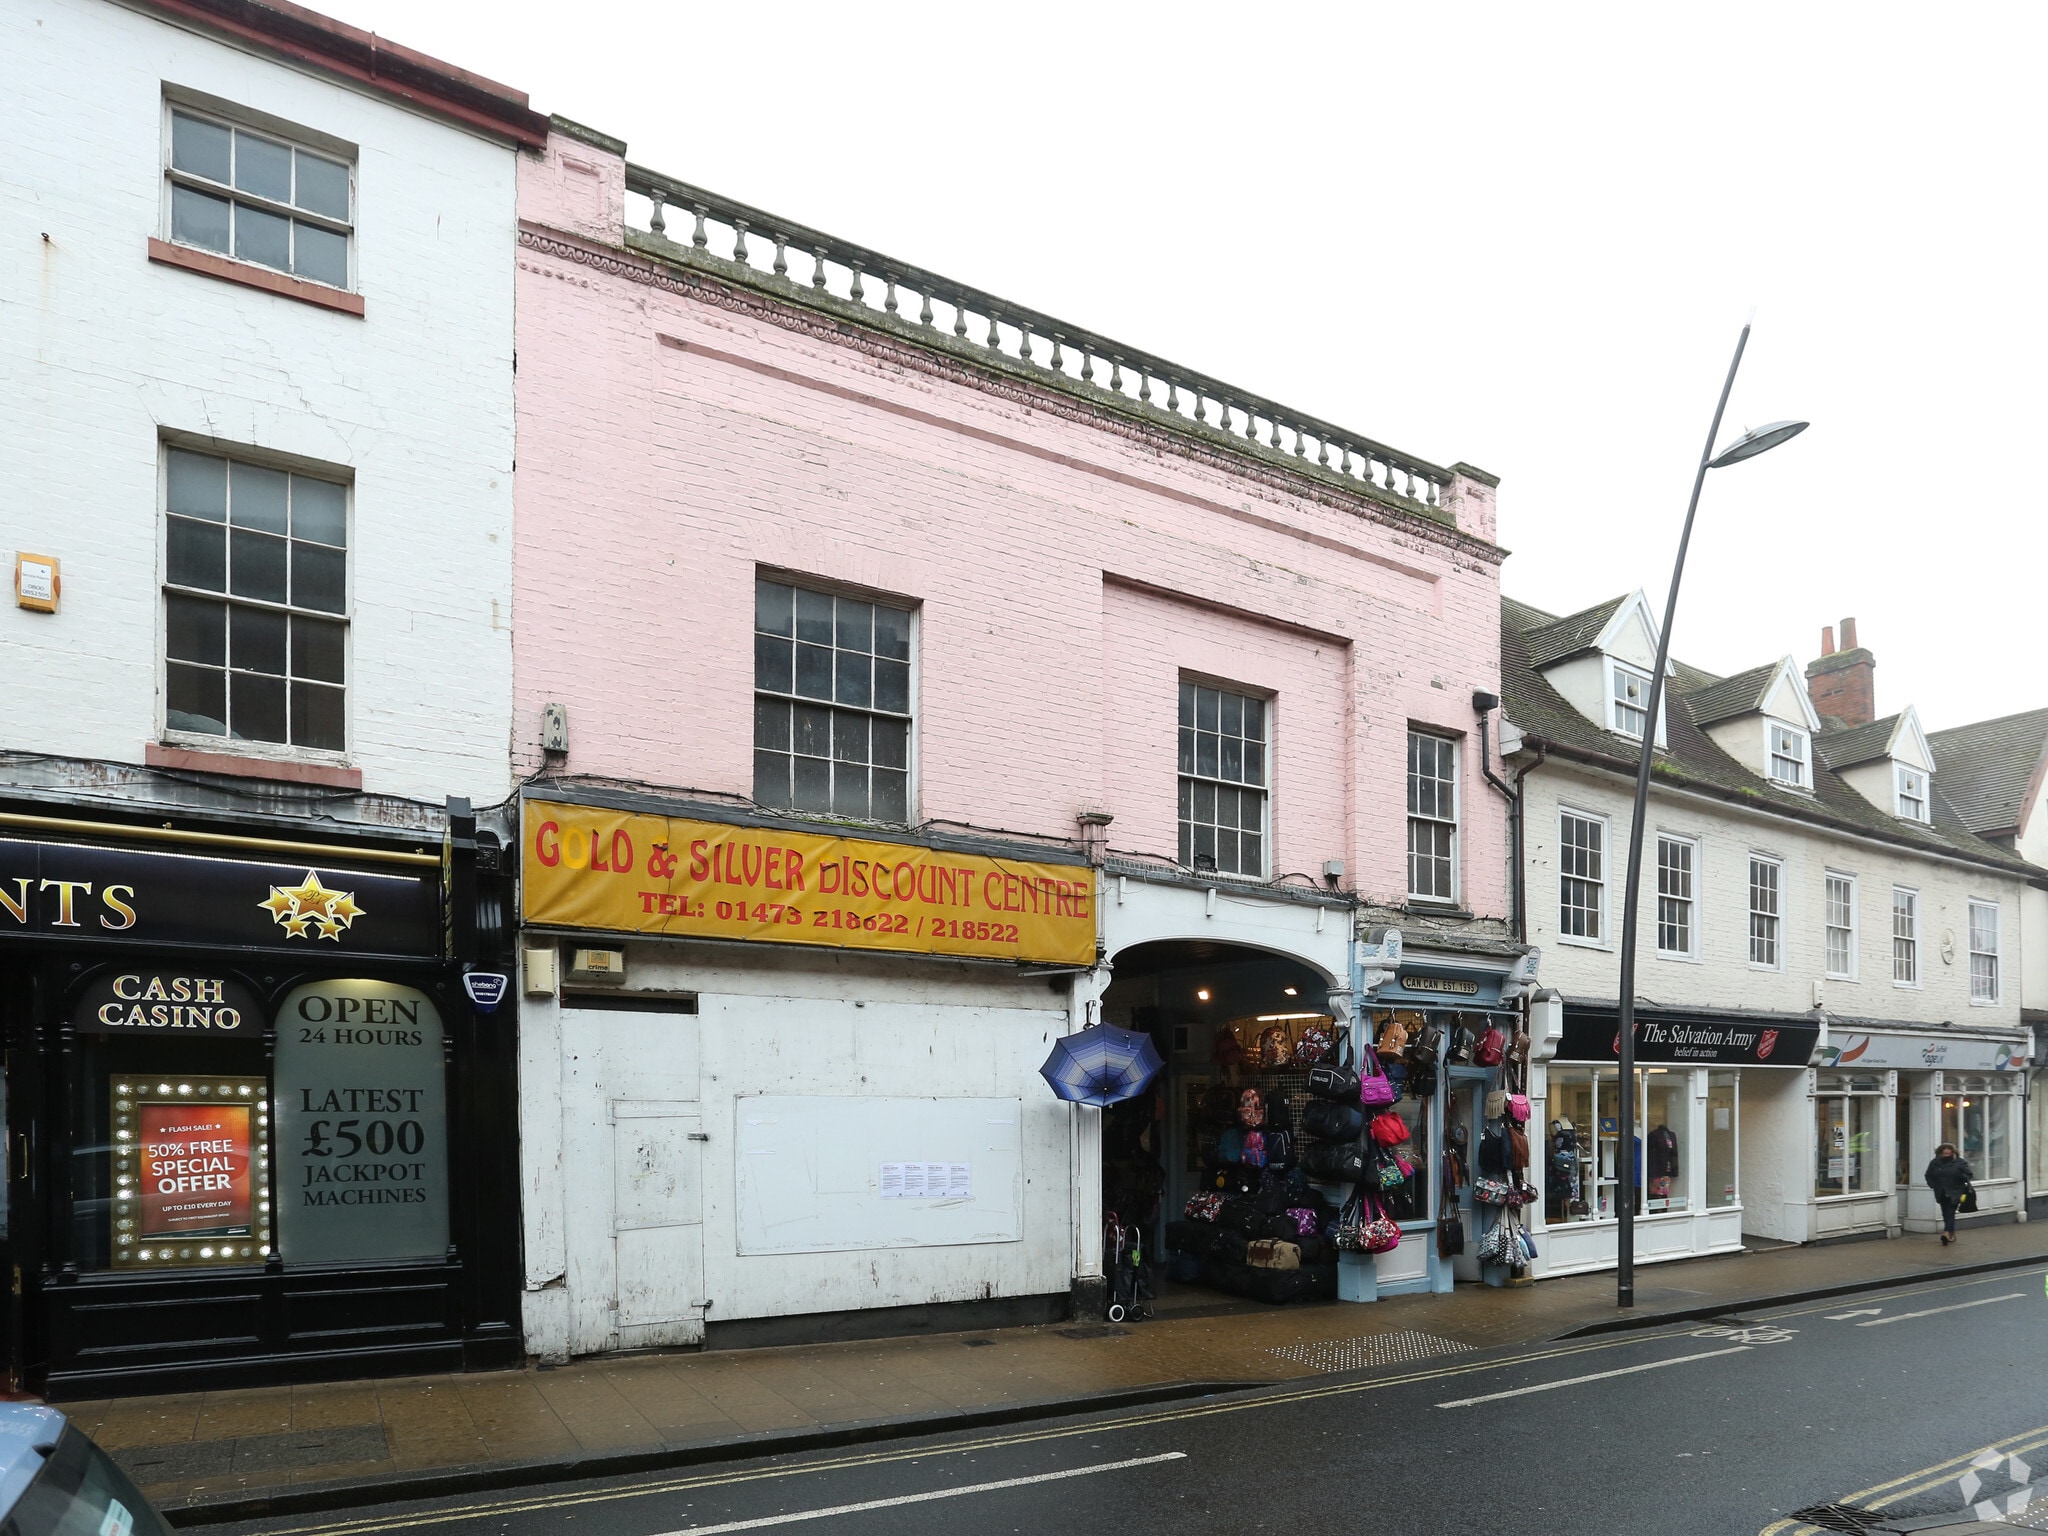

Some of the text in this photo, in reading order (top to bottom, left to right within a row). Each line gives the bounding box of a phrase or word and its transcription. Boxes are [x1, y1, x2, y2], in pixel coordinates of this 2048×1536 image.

[536, 821, 1089, 919] GOLD & SILVER DISCOUNT CENTRE
[638, 891, 1019, 943] TEL: 01473 218622 / 218522
[112, 975, 225, 1003] CASH
[1406, 978, 1422, 988] CAN
[1423, 979, 1438, 989] CAN
[1443, 981, 1457, 991] EST.
[98, 1003, 241, 1030] CASINO
[298, 996, 421, 1025] OPEN
[299, 1027, 423, 1046] 24 HOURS
[1643, 1023, 1667, 1043] The
[1668, 1024, 1723, 1045] Salvation
[1722, 1028, 1757, 1051] Army
[1674, 1047, 1718, 1058] belief in action
[300, 1088, 424, 1113] LATEST
[168, 1124, 213, 1133] FLASH SALE!
[301, 1119, 425, 1159] £500
[148, 1139, 234, 1158] 50% FREE
[151, 1156, 235, 1177] SPECIAL
[302, 1163, 426, 1187] JACKPOT
[158, 1173, 232, 1195] OFFER
[303, 1187, 426, 1207] MACHINES
